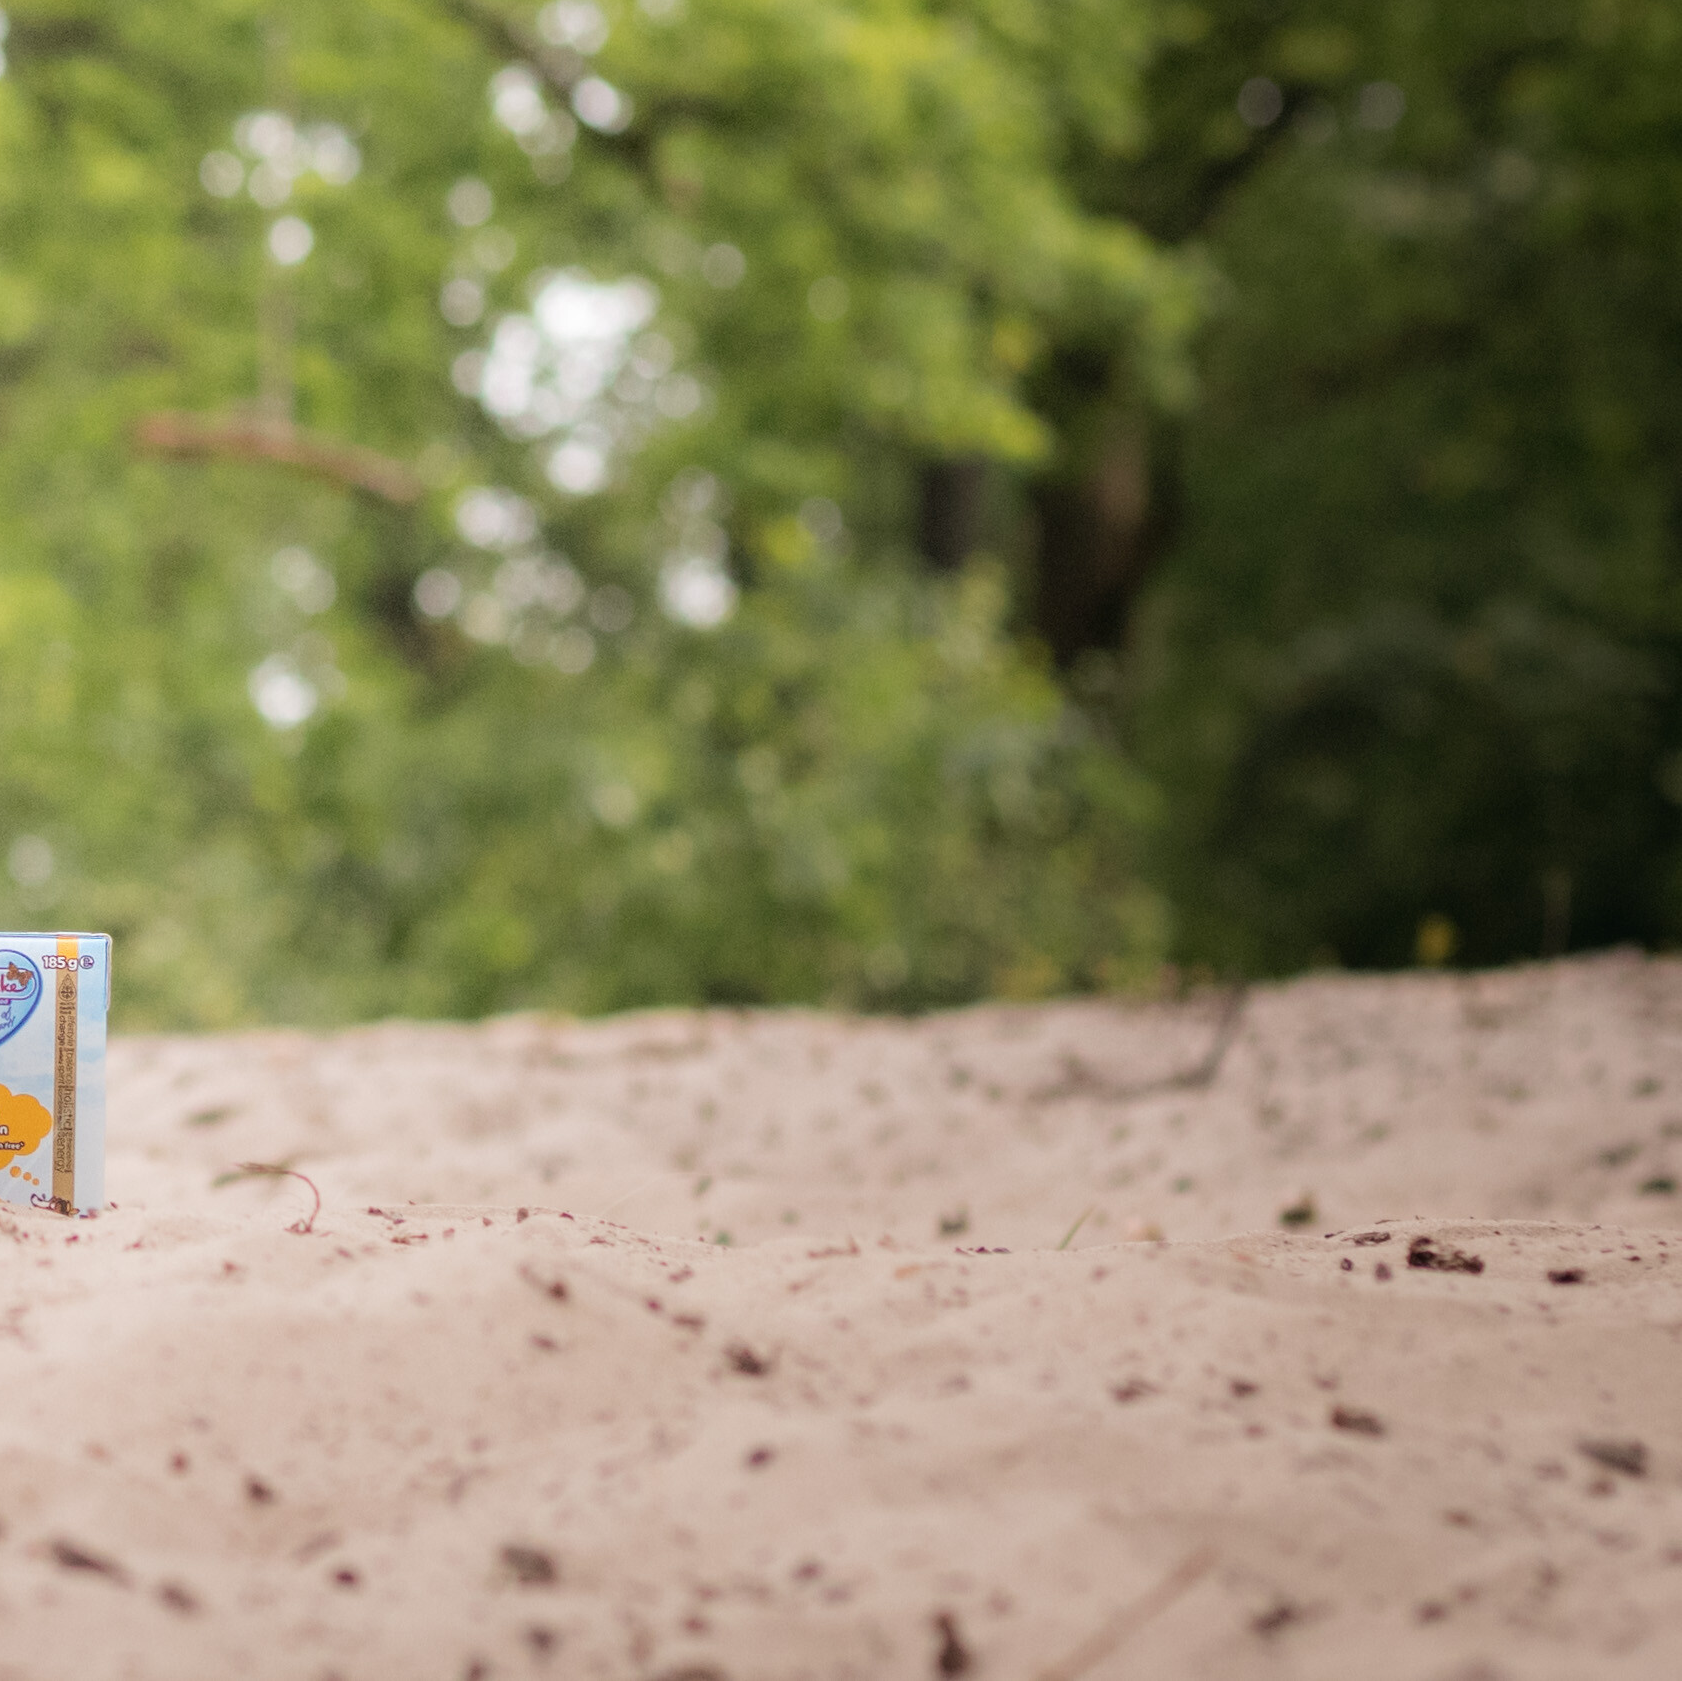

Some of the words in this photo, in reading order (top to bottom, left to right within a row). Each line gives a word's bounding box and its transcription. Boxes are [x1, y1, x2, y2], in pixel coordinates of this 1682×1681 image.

[41, 955, 66, 969] 185
[68, 958, 78, 971] g
[63, 1088, 74, 1127] holistic
[54, 1137, 66, 1174] energy
